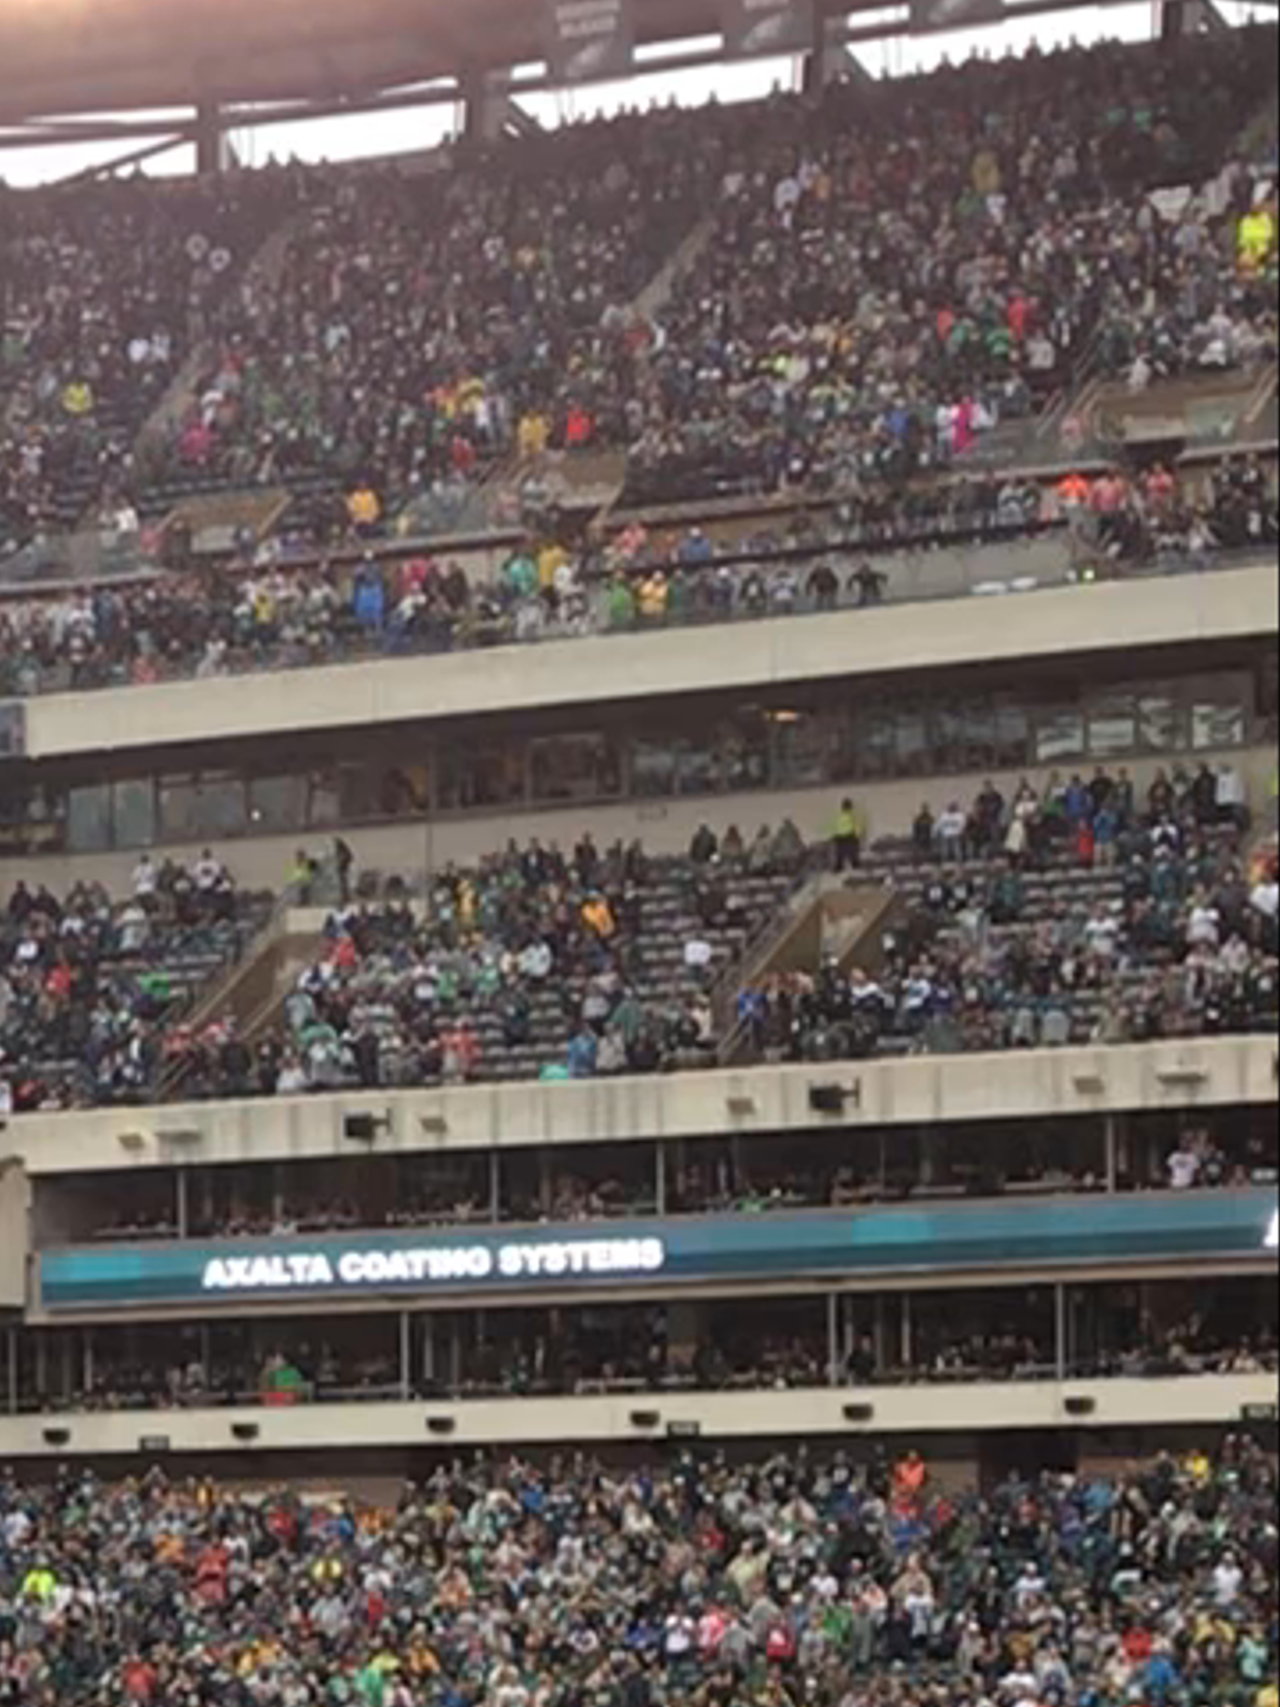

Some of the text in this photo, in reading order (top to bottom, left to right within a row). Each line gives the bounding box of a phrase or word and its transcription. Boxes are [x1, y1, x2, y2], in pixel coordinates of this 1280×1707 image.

[203, 1237, 664, 1288] AXALTA COATING SYSTEMS
